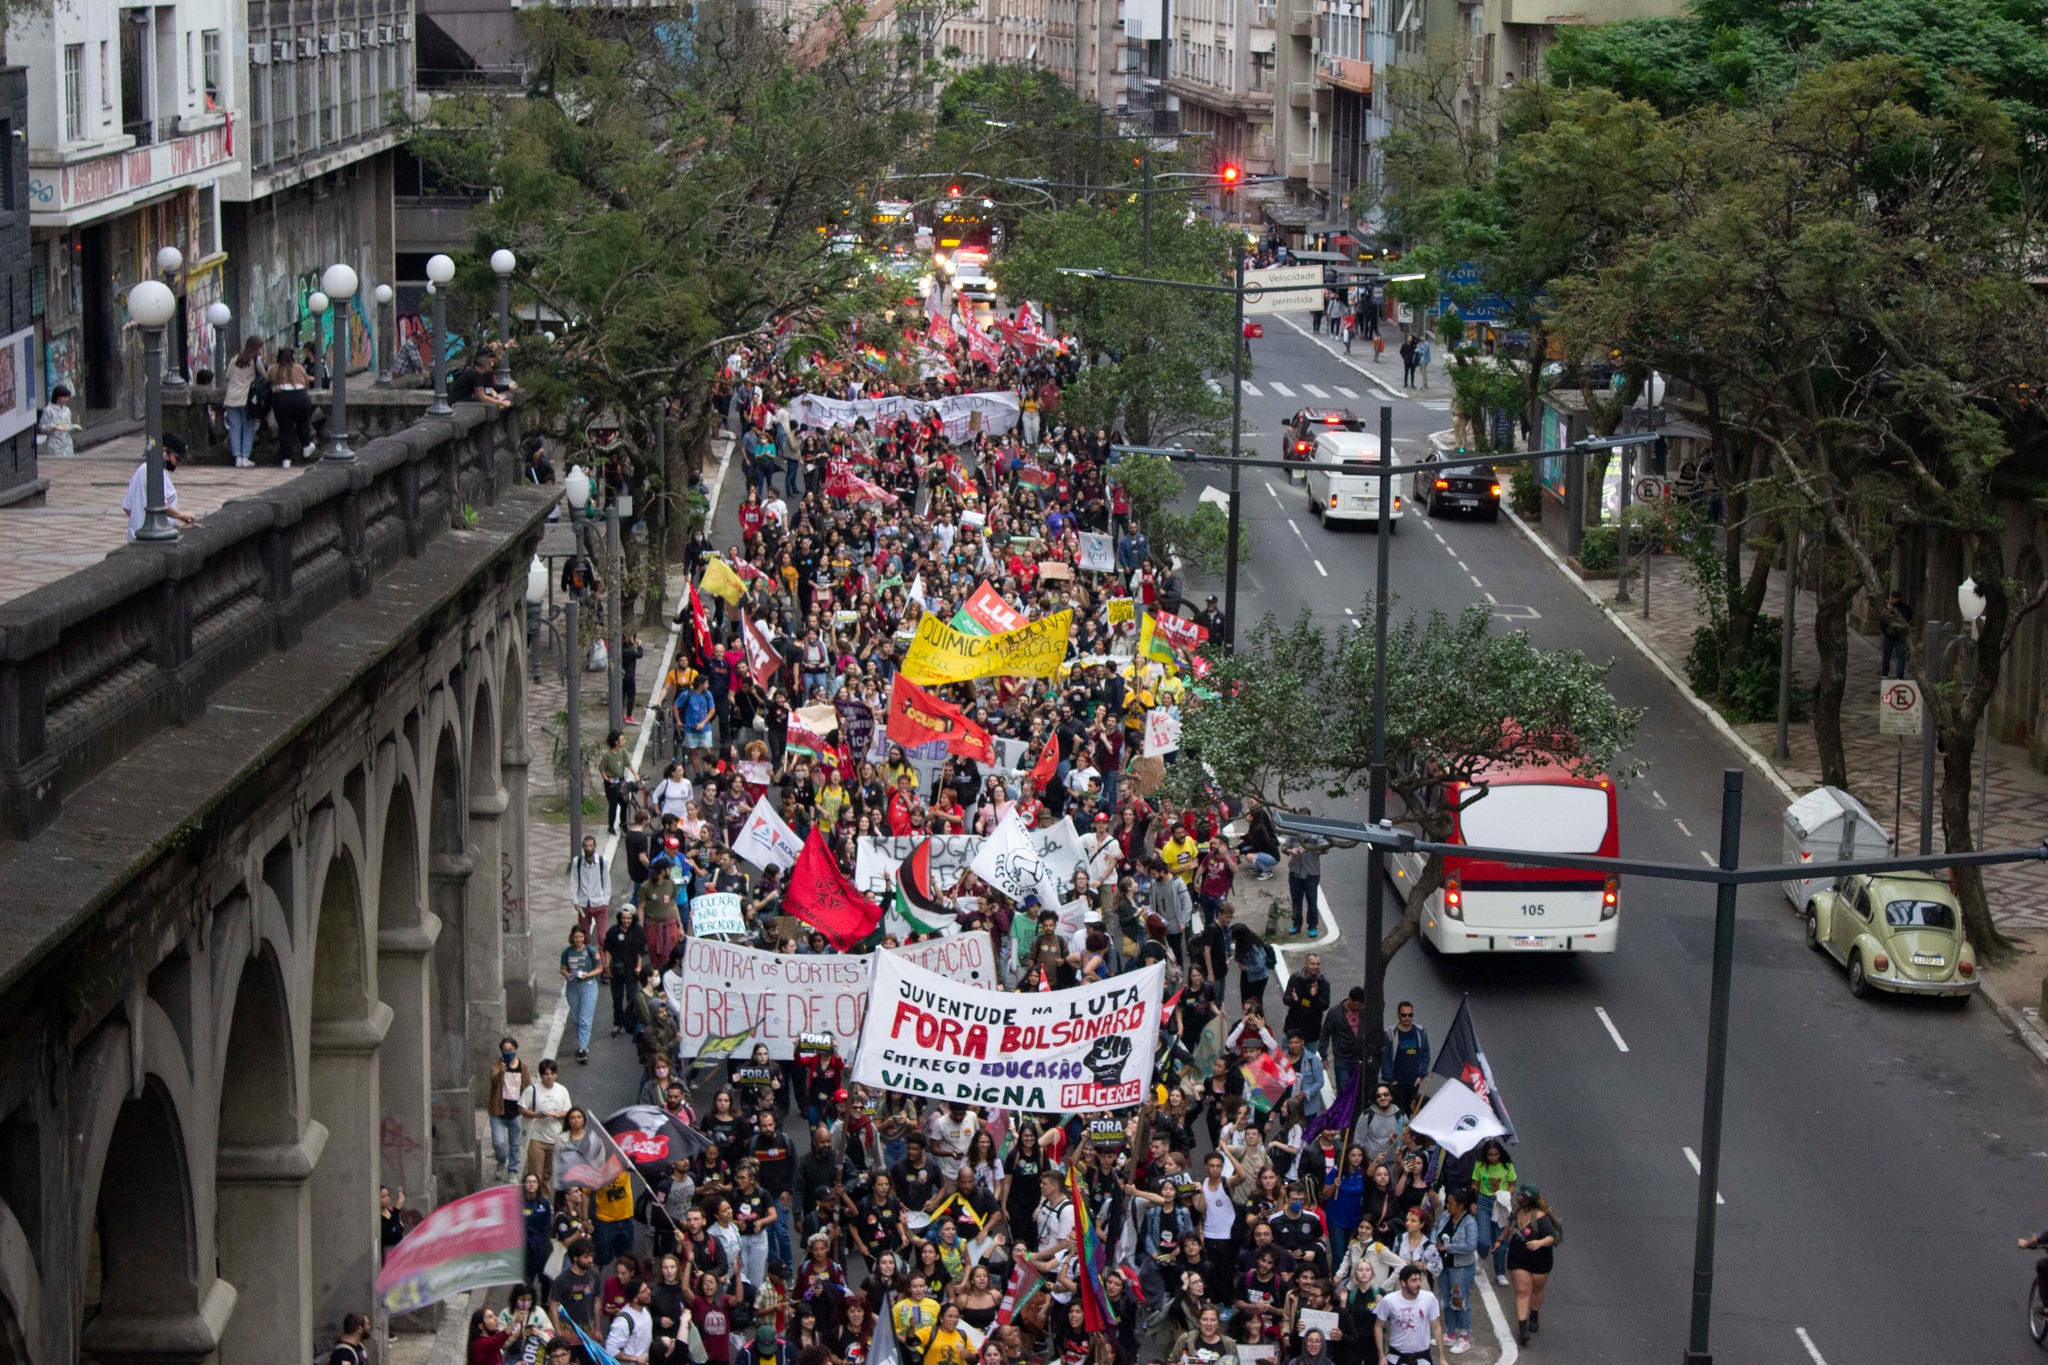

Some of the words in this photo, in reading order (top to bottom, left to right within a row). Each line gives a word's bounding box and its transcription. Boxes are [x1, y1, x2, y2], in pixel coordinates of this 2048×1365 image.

[1268, 271, 1316, 282] Velocidade
[1272, 296, 1313, 306] permitida
[1108, 600, 1133, 609] ENSINO
[698, 907, 718, 919] NÃO
[1521, 904, 1545, 916] 105
[688, 941, 755, 981] CONTRA
[785, 960, 860, 984] CORTES
[899, 979, 1017, 1026] JUVENTUDE
[1031, 1006, 1053, 1016] NA
[1069, 984, 1140, 1020] LUTA
[684, 984, 780, 1039] GREVE
[890, 1000, 989, 1060] FORA
[1000, 1001, 1146, 1054] BOLSONARO
[800, 1032, 832, 1045] FORA
[883, 1049, 970, 1075] EMPREGO
[980, 1058, 1083, 1080] EDUCAÇÃO
[740, 1068, 770, 1080] FORA
[1090, 1120, 1123, 1133] FORA
